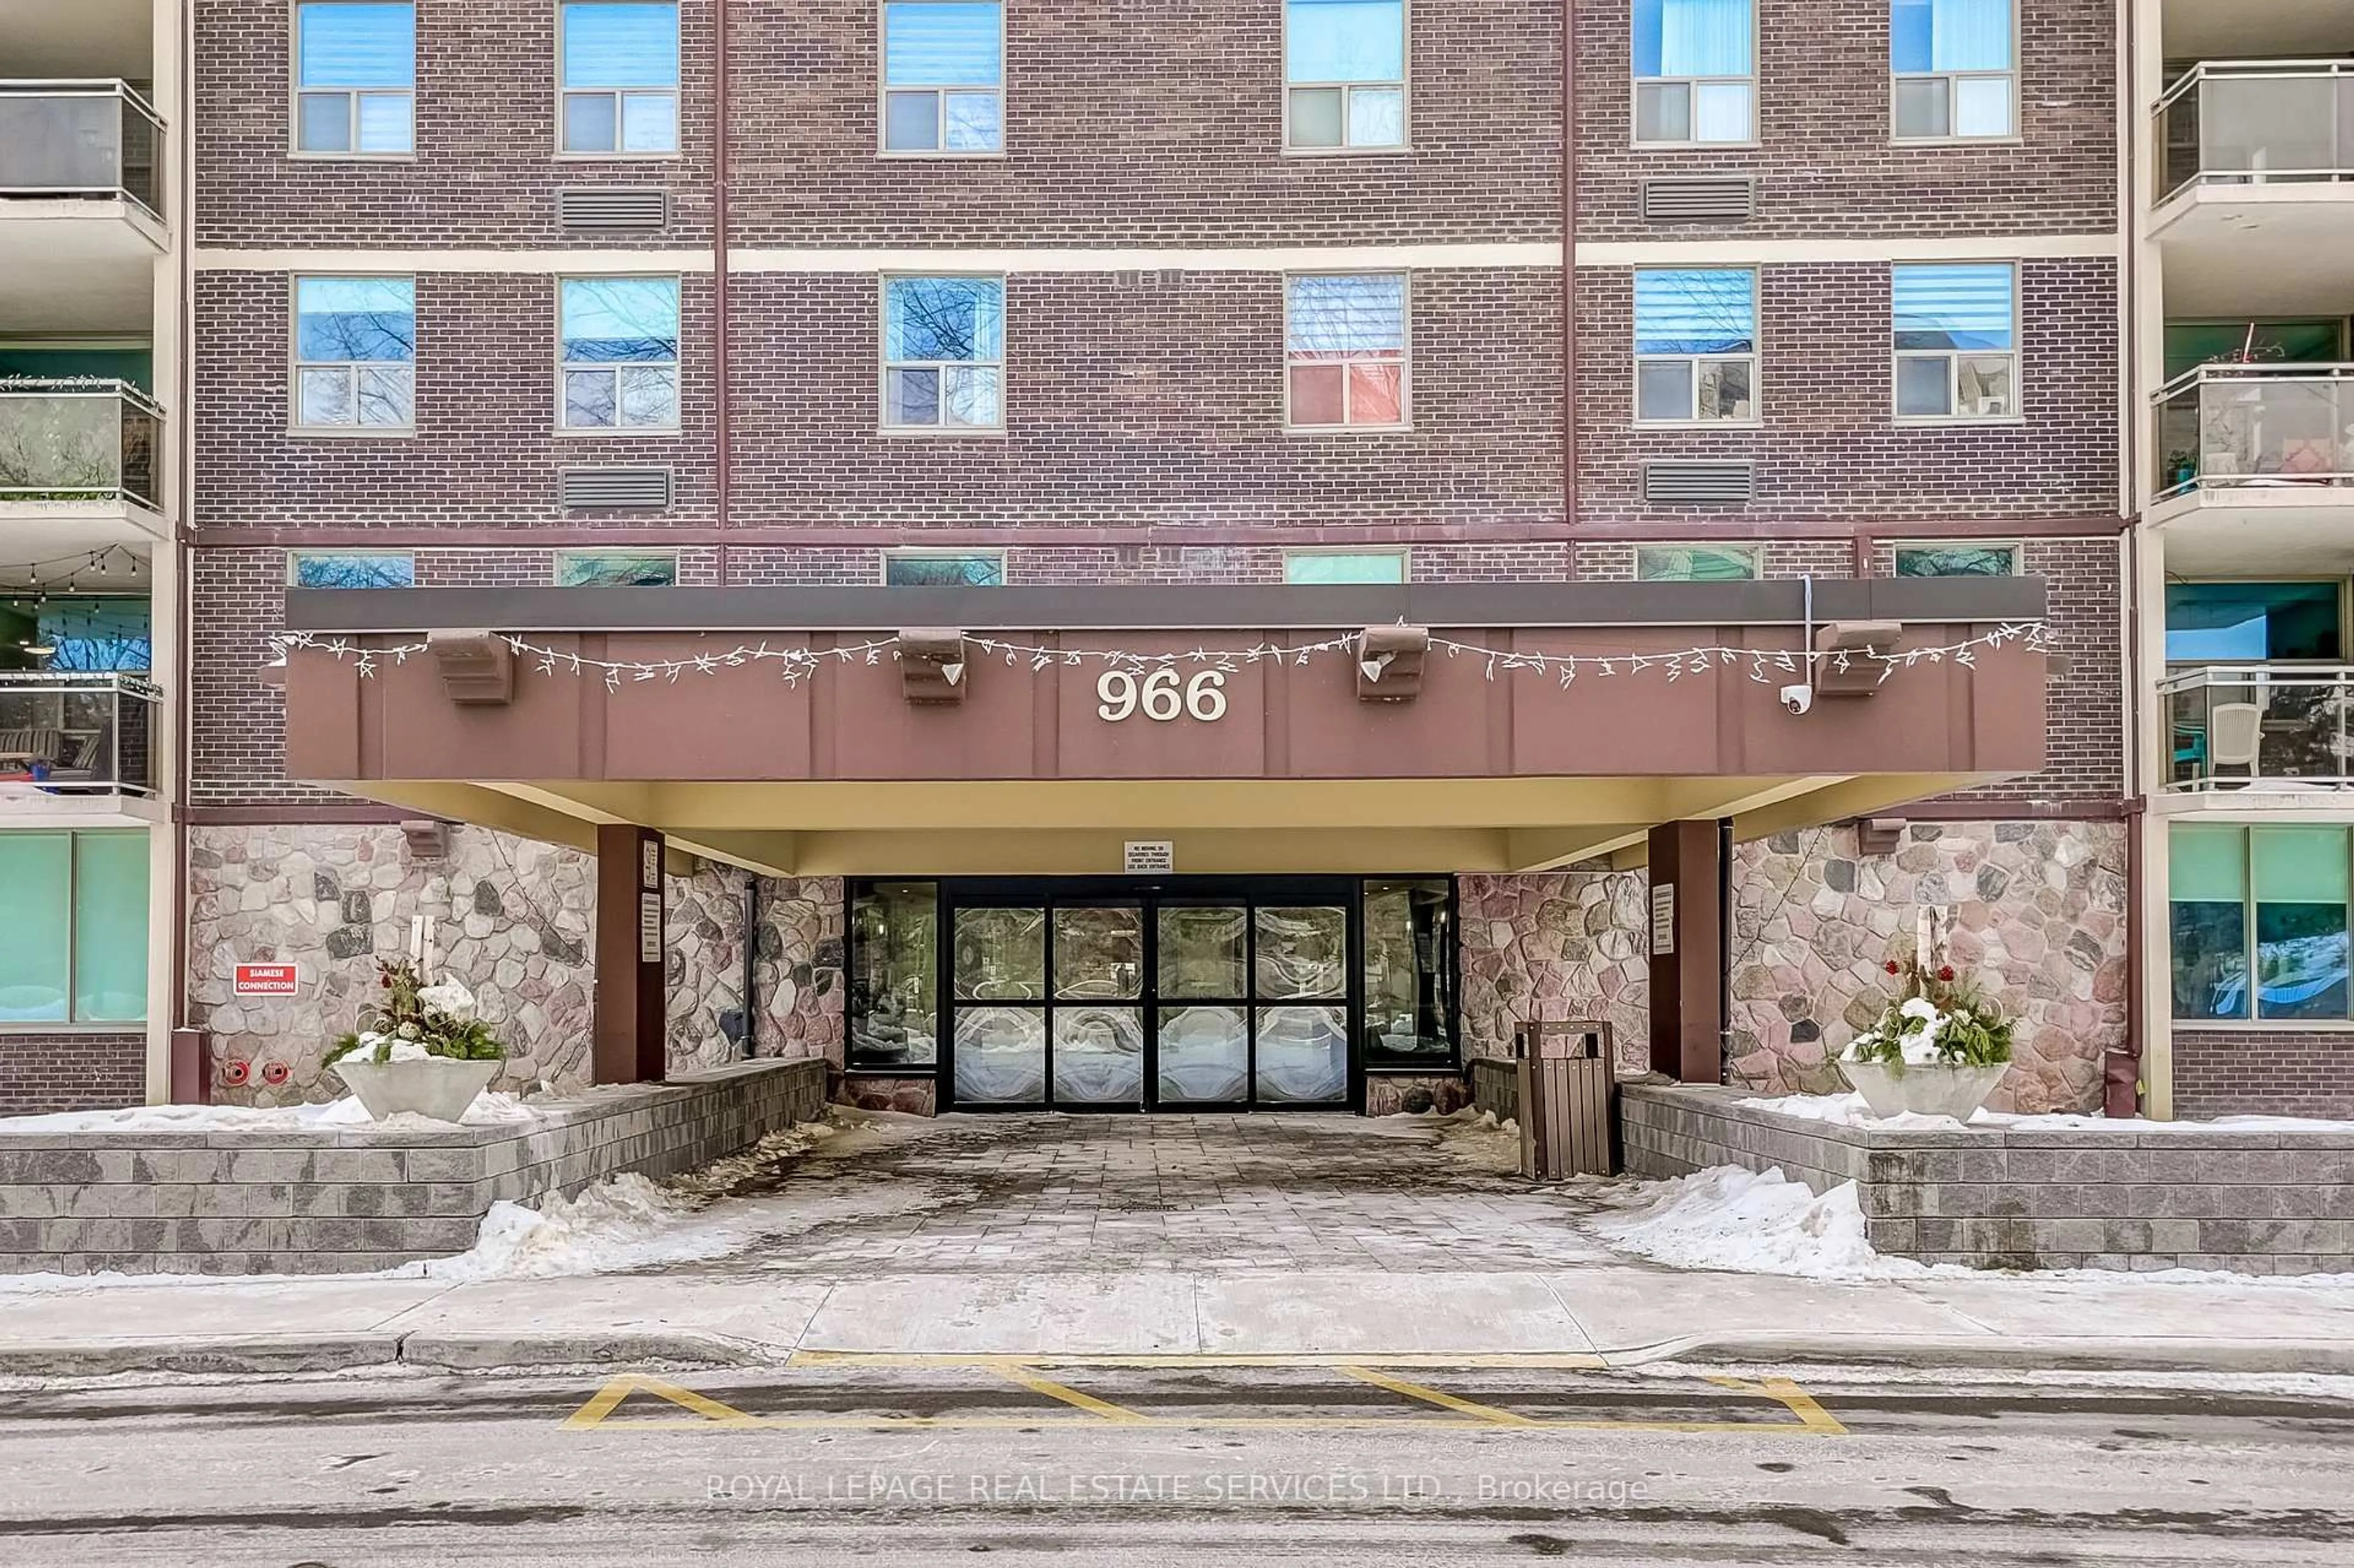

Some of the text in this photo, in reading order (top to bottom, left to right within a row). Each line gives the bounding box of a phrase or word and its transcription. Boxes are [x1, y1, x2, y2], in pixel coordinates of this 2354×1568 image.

[1097, 670, 1227, 721] 966
[249, 969, 284, 978] SIAMESE
[238, 981, 294, 990] CONNECTION
